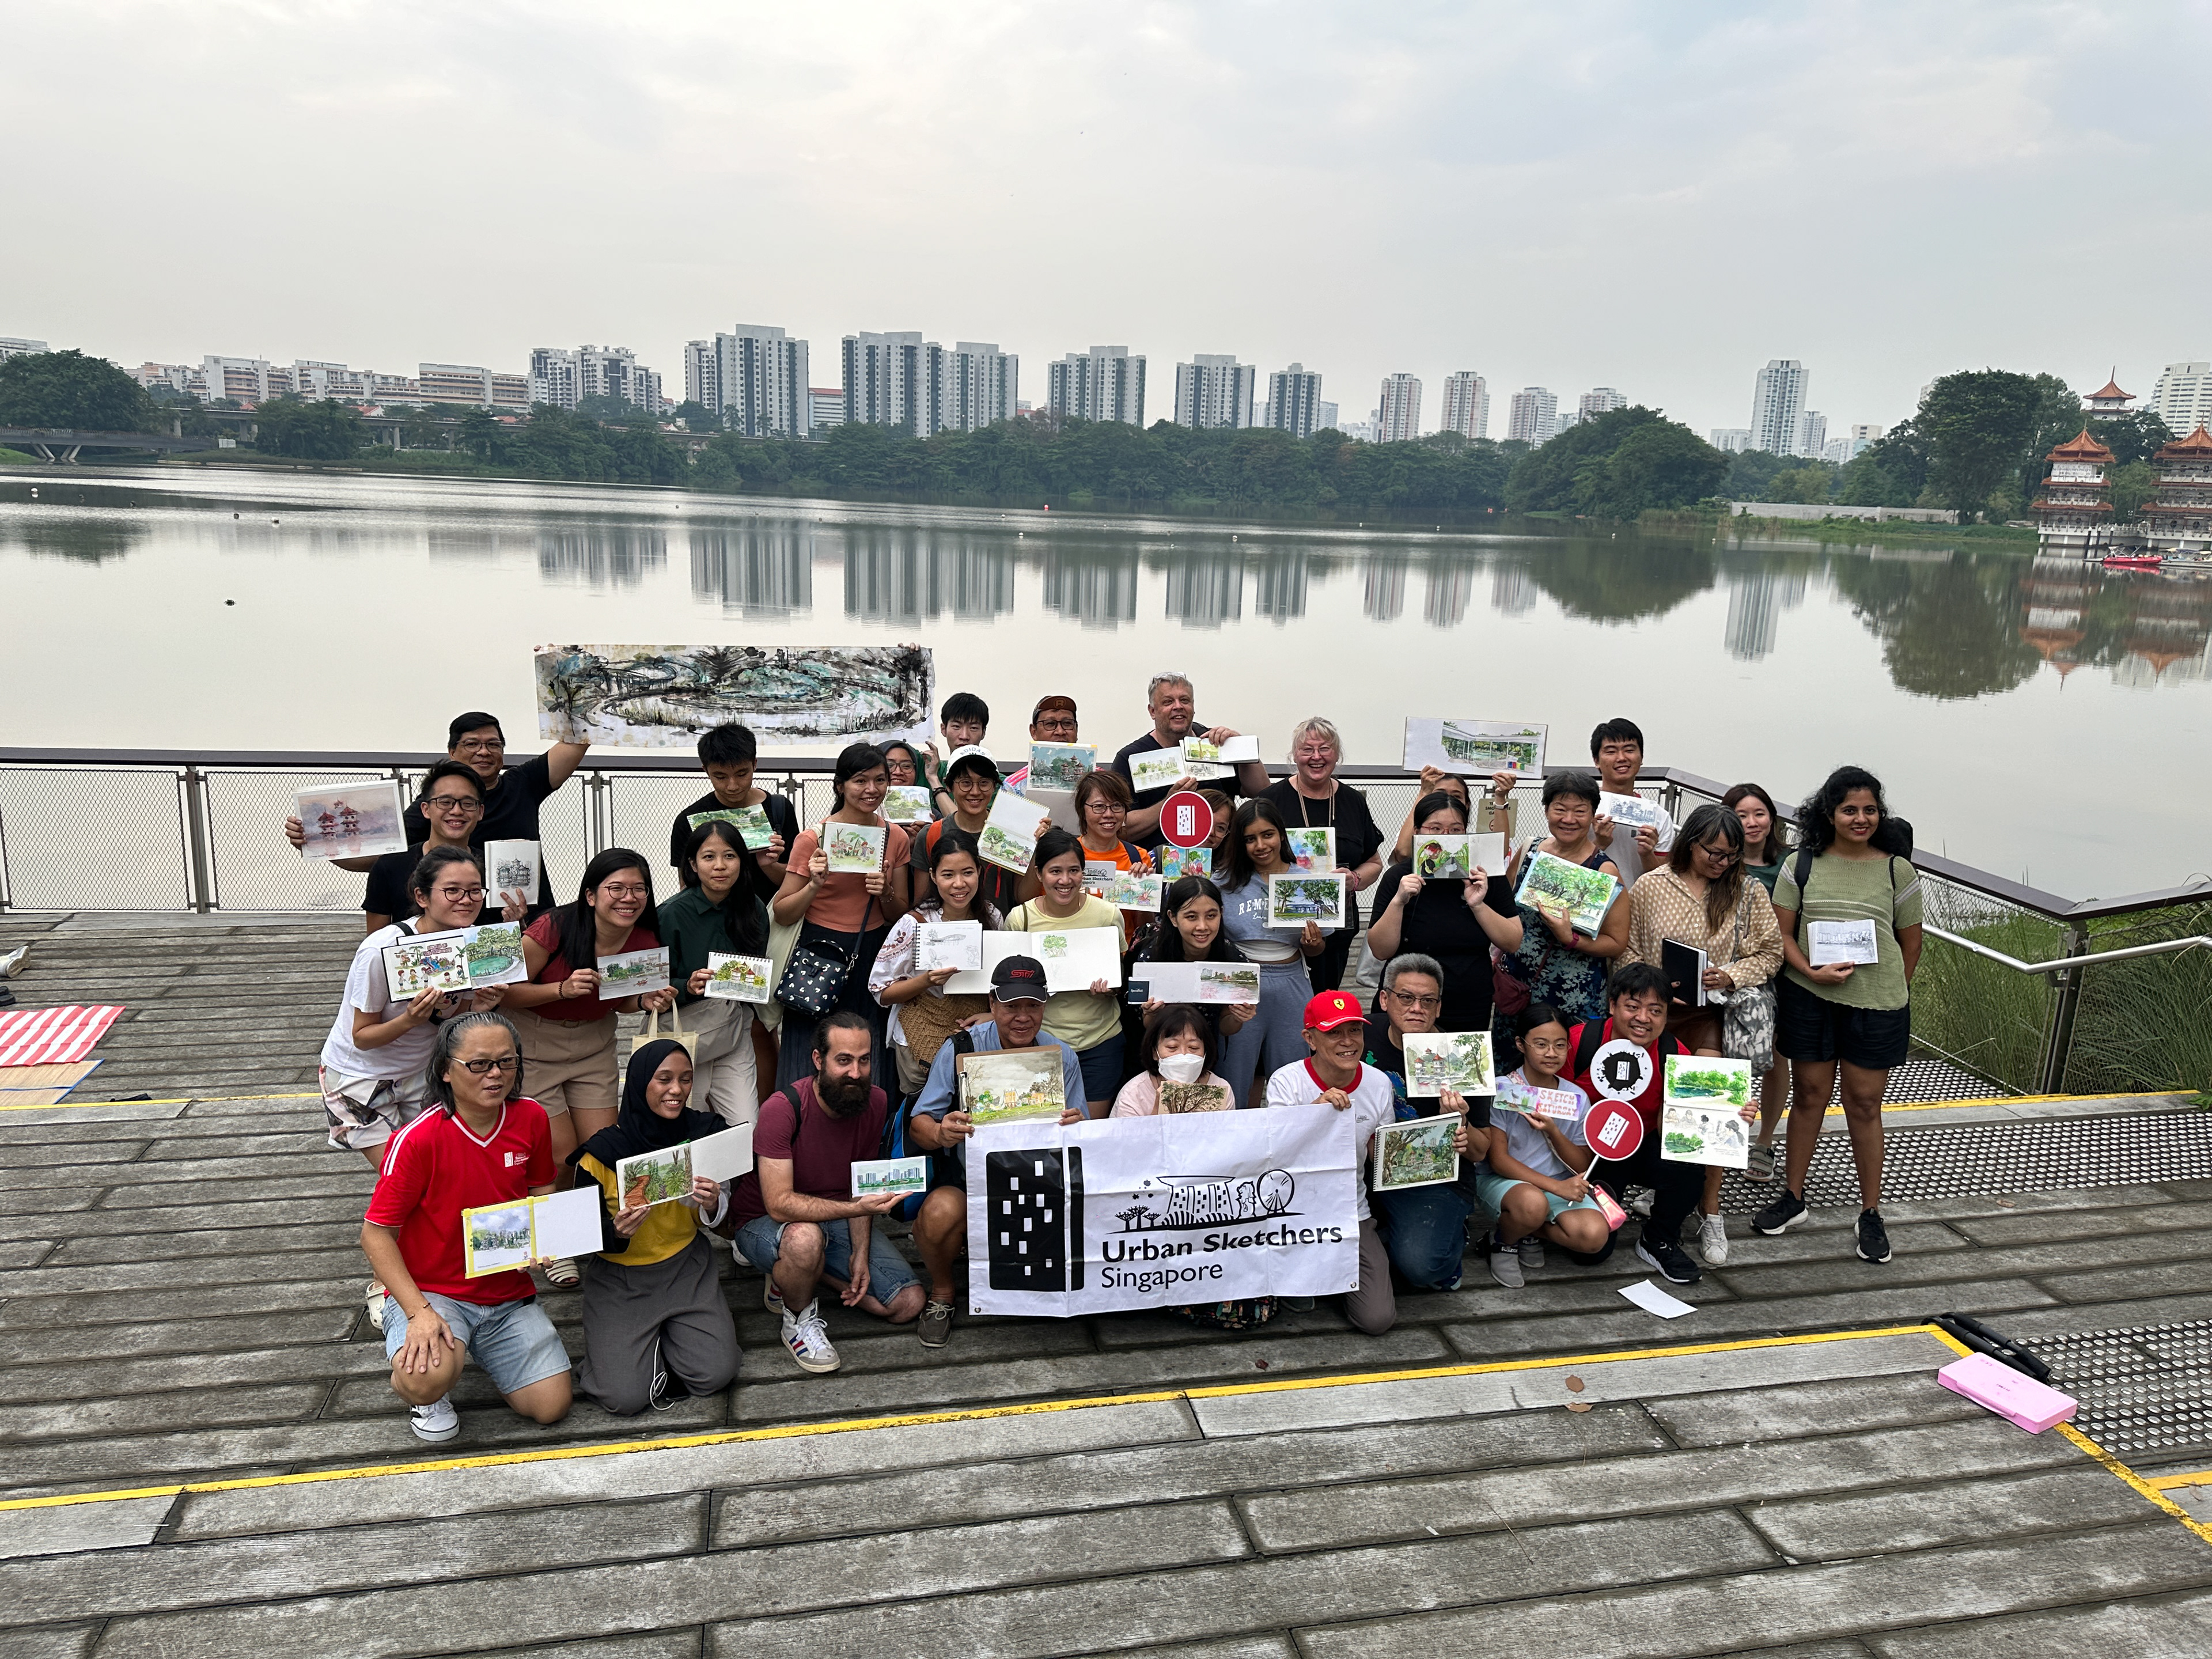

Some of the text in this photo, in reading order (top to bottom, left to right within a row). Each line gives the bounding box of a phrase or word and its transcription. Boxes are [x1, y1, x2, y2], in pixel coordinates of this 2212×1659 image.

[960, 747, 986, 755] ADIDAS
[1539, 1090, 1574, 1105] SKETCH
[1102, 1224, 1343, 1263] Urban Sketchers
[1101, 1264, 1223, 1293] Singapore
